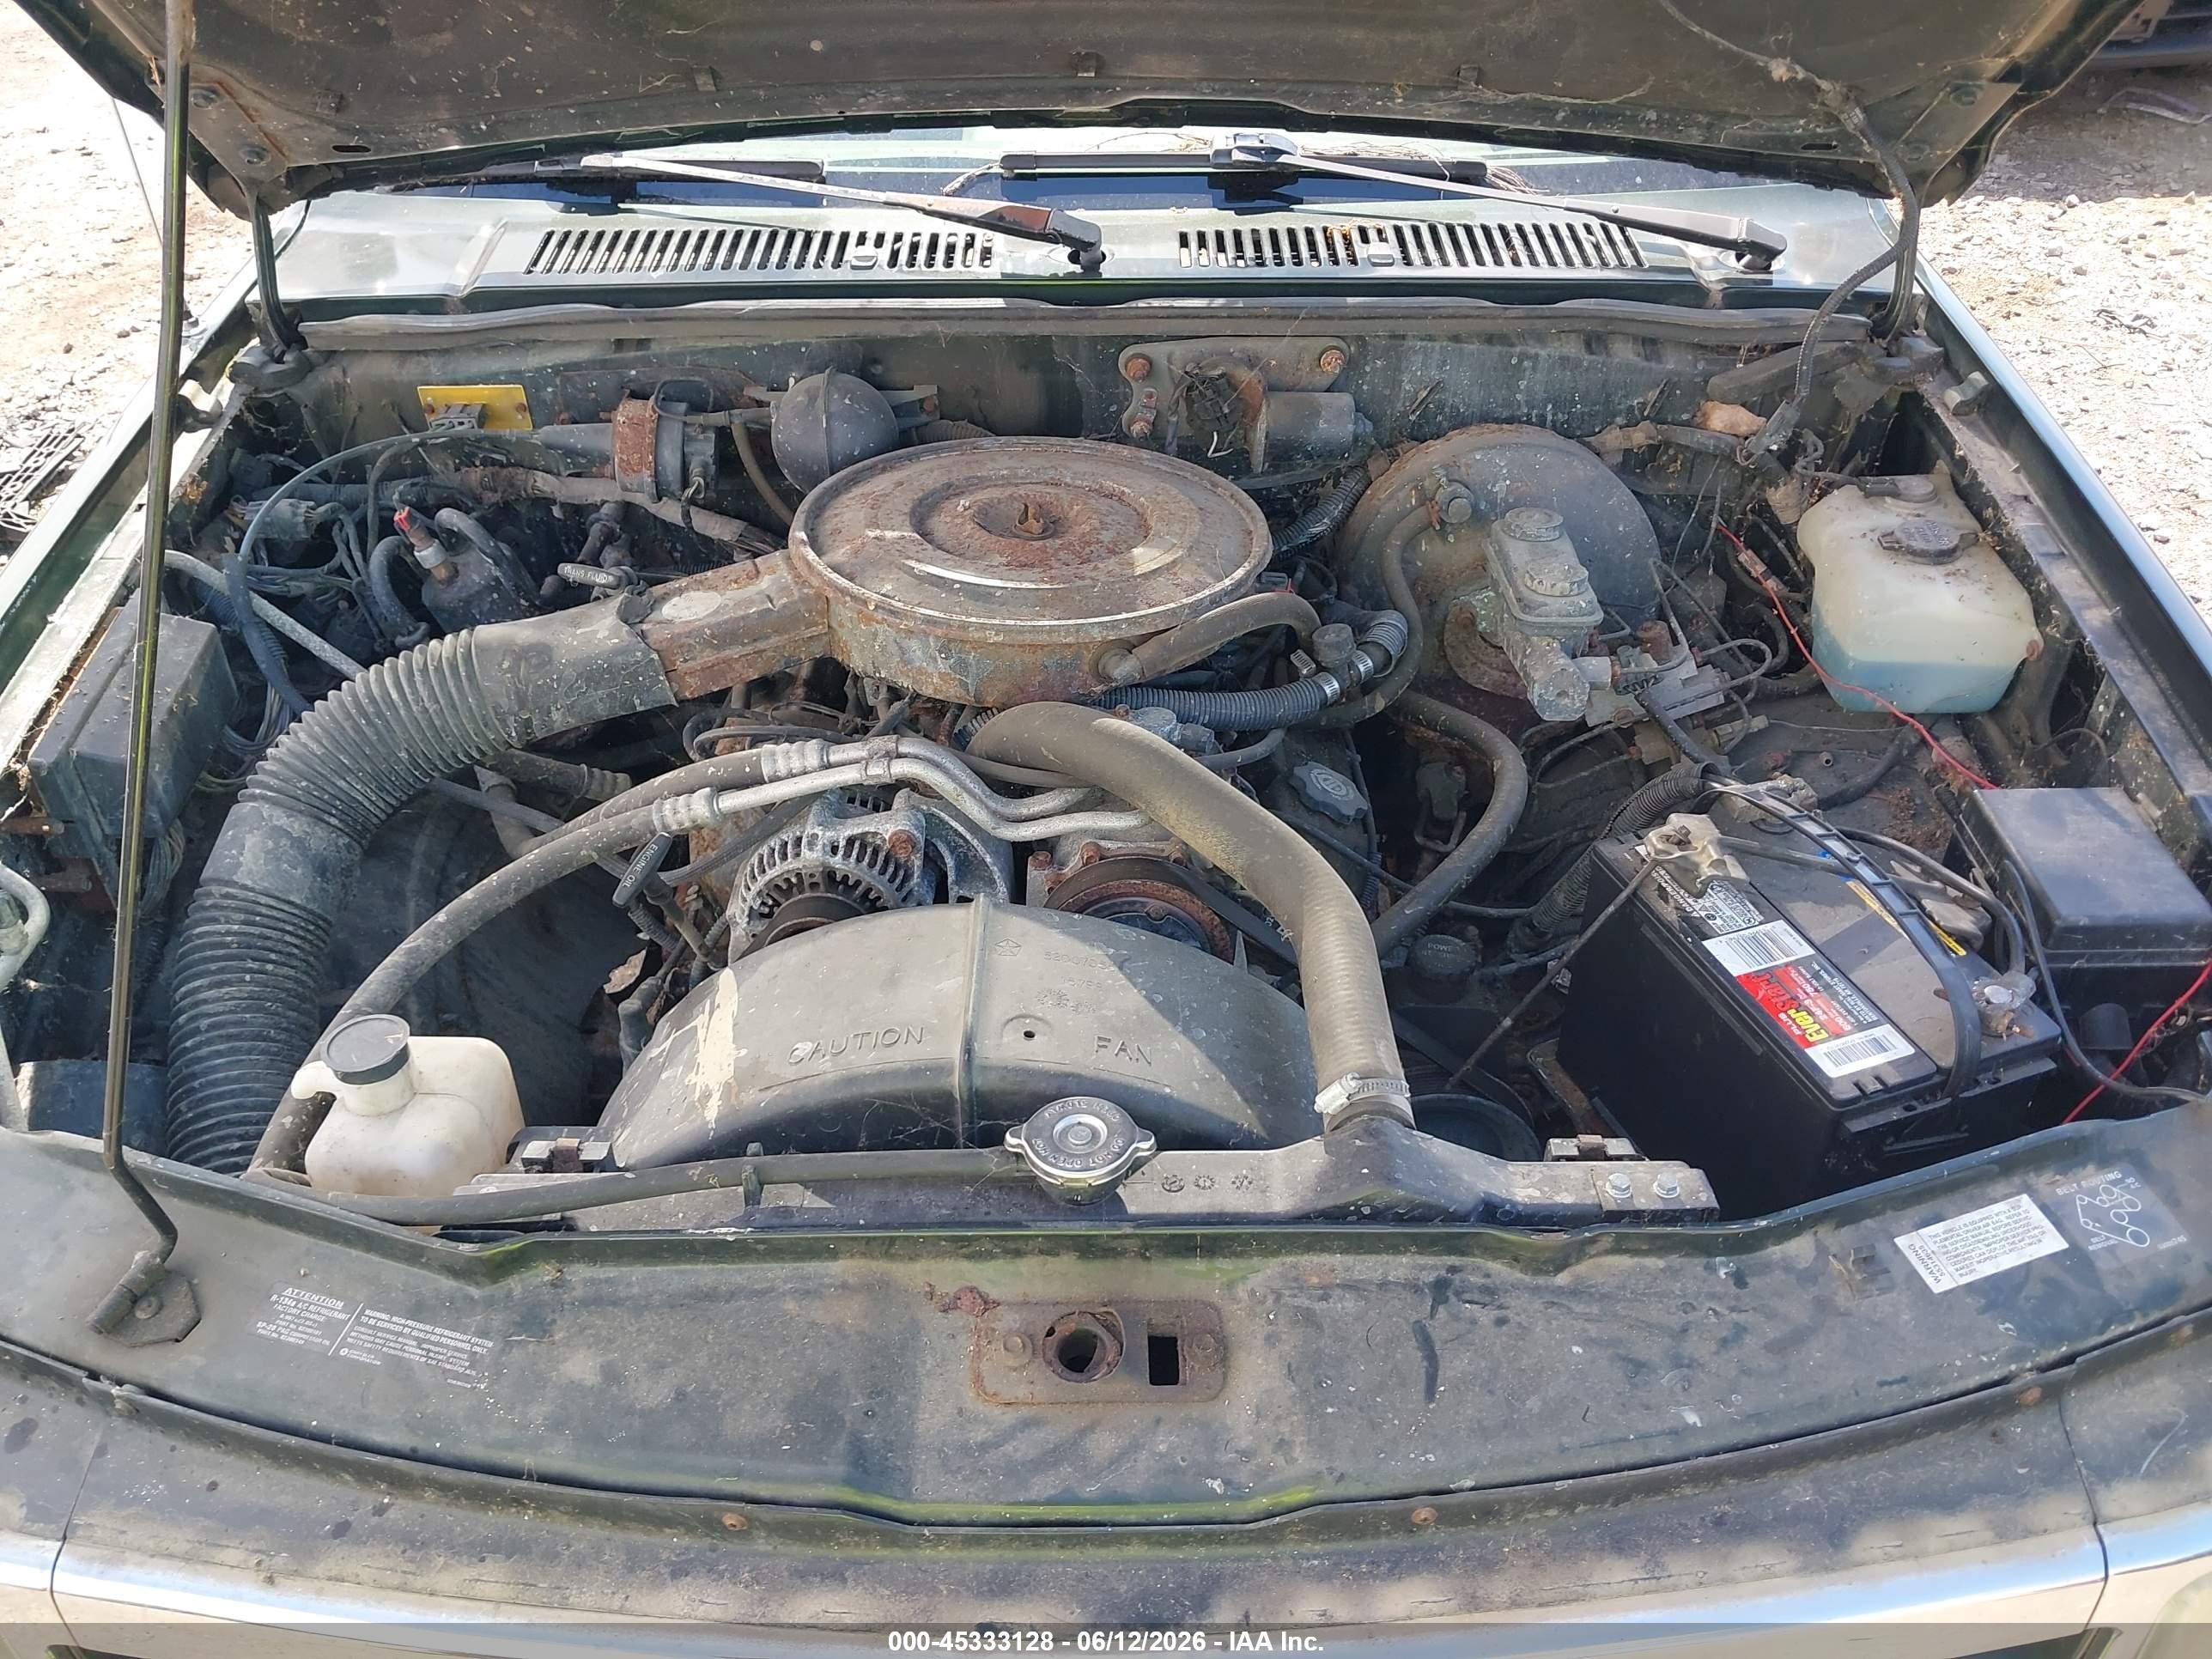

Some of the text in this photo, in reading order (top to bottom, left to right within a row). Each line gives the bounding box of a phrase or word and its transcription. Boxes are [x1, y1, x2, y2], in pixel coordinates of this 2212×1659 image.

[564, 566, 585, 577] TRANS
[622, 843, 659, 888] ENGINE OIL
[788, 1025, 1153, 1066] CAUTION FAN
[1032, 1138, 1049, 1157] HOT
[1049, 1153, 1082, 1168] OPEN
[1089, 1152, 1112, 1167] NOT
[2055, 1170, 2123, 1194] BELT ROUTING
[1907, 1243, 1941, 1283] WARNING
[283, 1287, 343, 1307] ATTENTION
[273, 1304, 300, 1314] FACTORY
[301, 1310, 325, 1321] CHARGE
[307, 1304, 350, 1320] REFRIGERANT
[433, 1327, 471, 1340] REFRIGERANT
